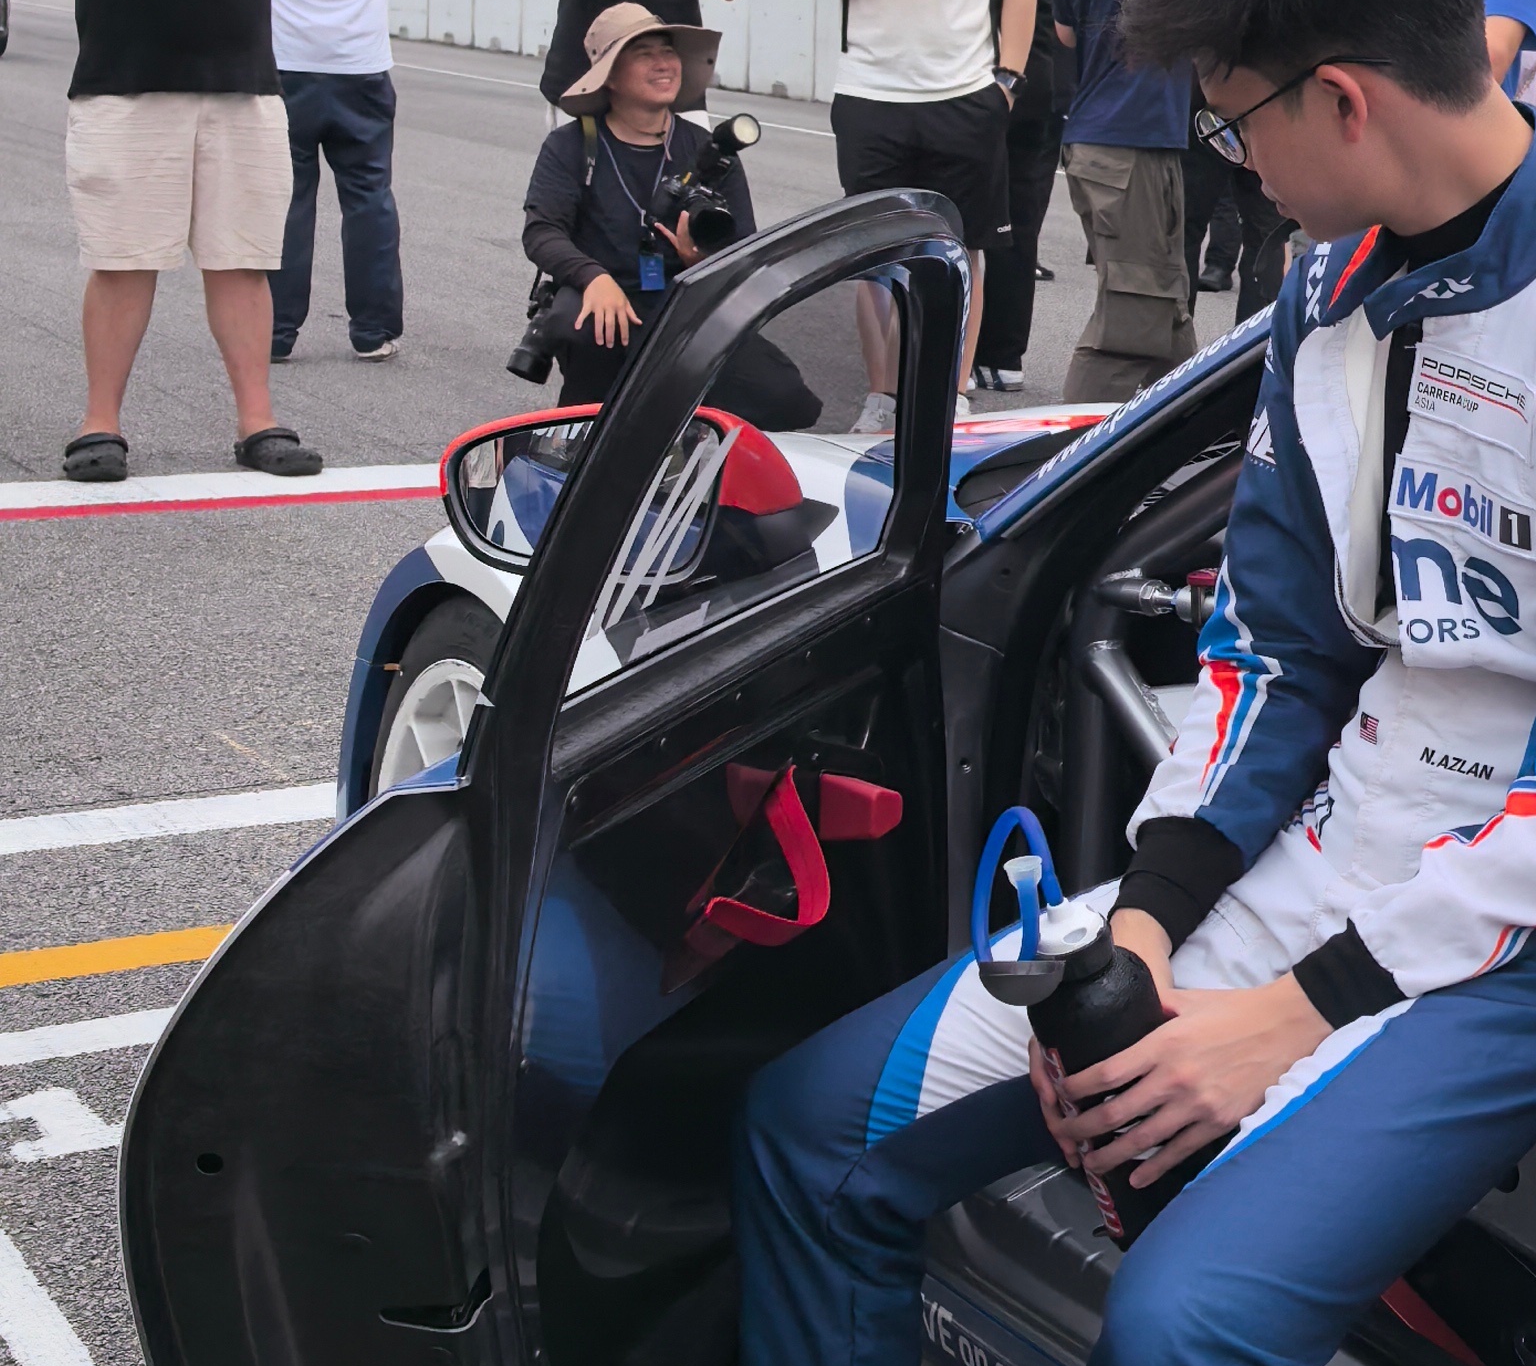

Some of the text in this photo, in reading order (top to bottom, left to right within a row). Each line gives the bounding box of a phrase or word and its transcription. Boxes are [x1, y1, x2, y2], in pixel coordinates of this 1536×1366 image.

[1415, 395, 1436, 412] ASIA
[1417, 382, 1479, 413] CARRERA CUP
[1422, 357, 1526, 411] PORSCHE
[1396, 467, 1520, 546] Mobil 1
